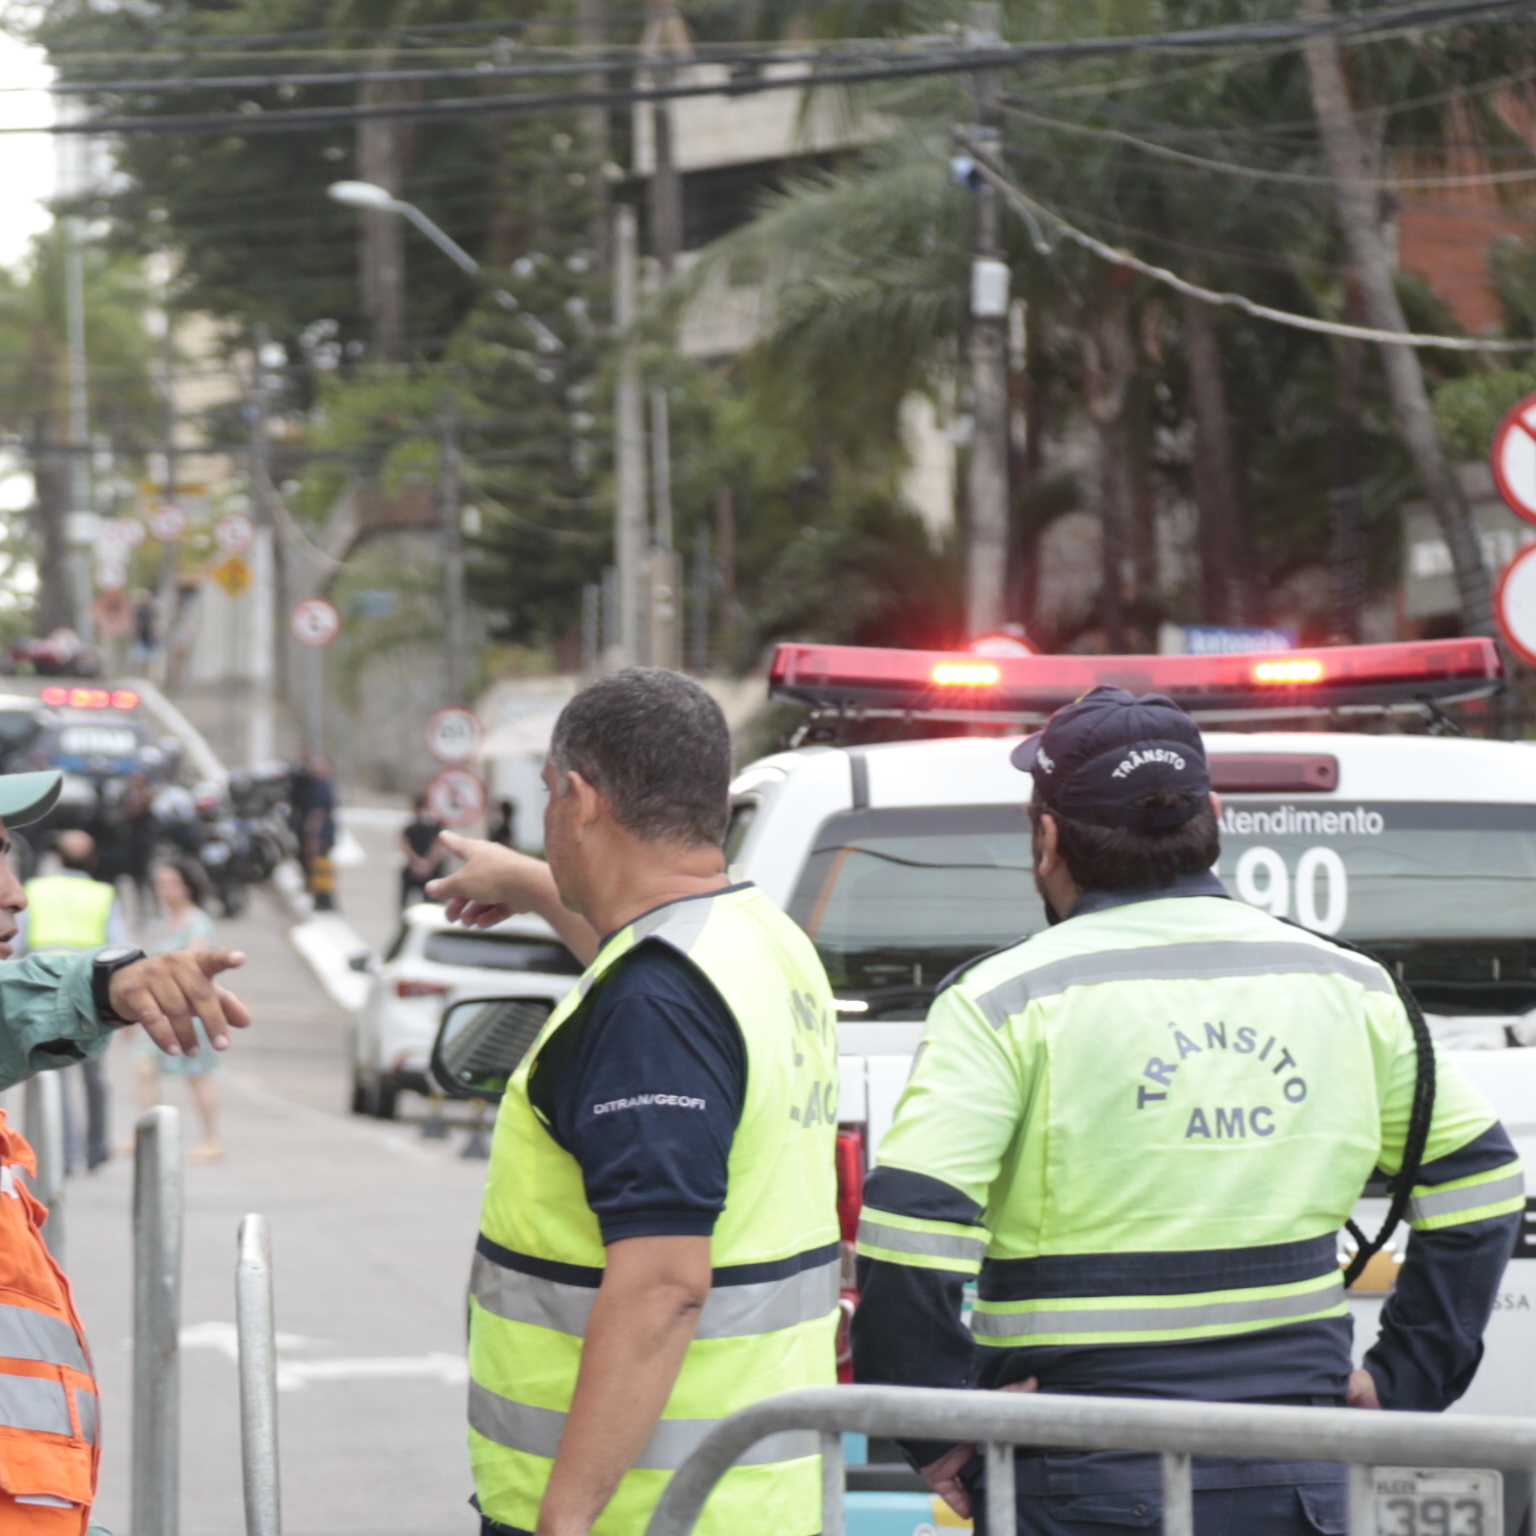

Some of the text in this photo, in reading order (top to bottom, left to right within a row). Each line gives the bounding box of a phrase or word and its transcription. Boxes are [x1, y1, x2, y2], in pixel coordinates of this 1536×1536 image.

[1111, 748, 1186, 779] TRÂNSITO
[1213, 846, 1349, 935] 90
[1137, 1021, 1307, 1109] TRÂNSITO
[1185, 1106, 1276, 1138] AMC
